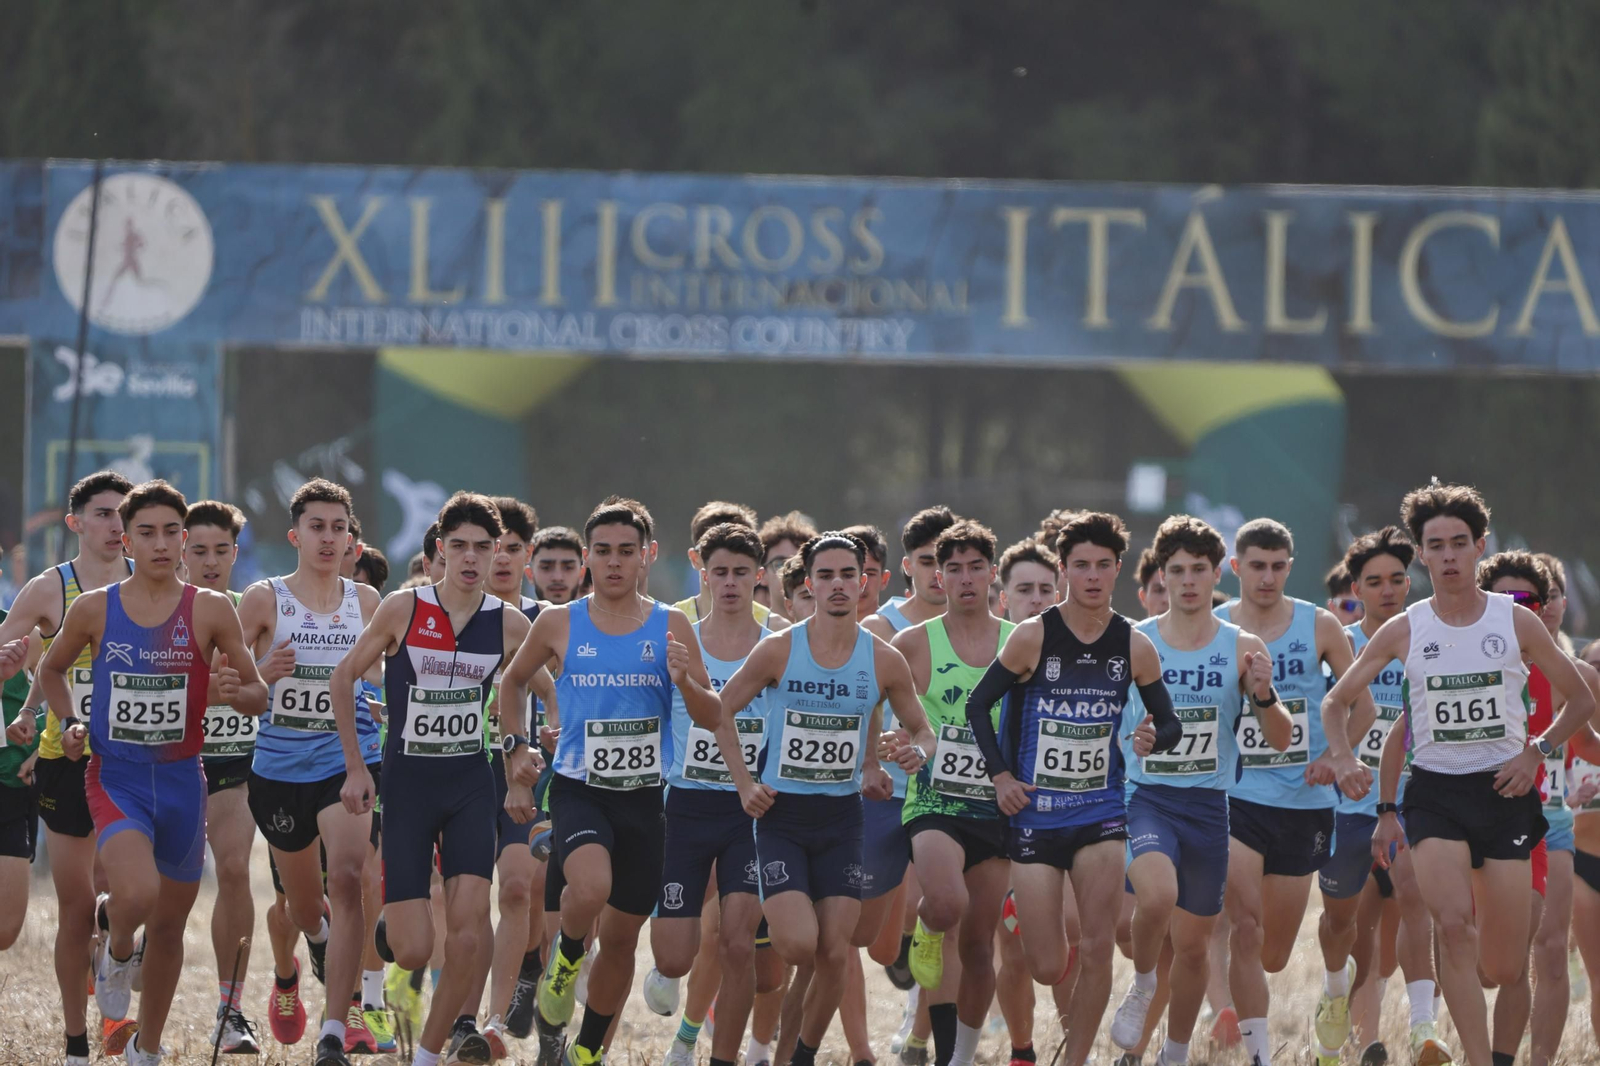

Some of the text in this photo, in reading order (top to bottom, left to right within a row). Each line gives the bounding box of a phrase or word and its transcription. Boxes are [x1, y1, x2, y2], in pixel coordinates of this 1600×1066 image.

[309, 195, 618, 307] XLIII
[631, 203, 885, 275] CROSS
[1002, 184, 1600, 338] ITÁLICA
[300, 306, 915, 354] INTERNATIONAL CROSS COUNTRY
[290, 632, 357, 646] MARACENA
[418, 627, 443, 640] VIATOR
[131, 675, 168, 688] ITÁLICA
[571, 674, 663, 688] TROTASIERRA
[1162, 664, 1224, 692] erja
[1446, 674, 1484, 687] ITÁLICA
[281, 688, 335, 714] 616
[430, 690, 466, 701] ITÁLICA
[787, 679, 851, 701] nerja
[1051, 688, 1117, 697] CLUB ATLETISMO
[116, 700, 181, 725] 8255
[795, 699, 841, 710] ATLETISMO
[1036, 697, 1122, 719] NARÓN
[1435, 697, 1501, 725] 6161
[414, 713, 478, 737] 6400
[608, 721, 645, 734] ITÁLICA
[805, 715, 843, 727] ITÁLICA
[1061, 725, 1097, 736] ITÁLICA
[593, 744, 656, 771] 8283
[693, 739, 758, 767] 823
[787, 738, 854, 764] 8280
[1043, 747, 1105, 774] 6156
